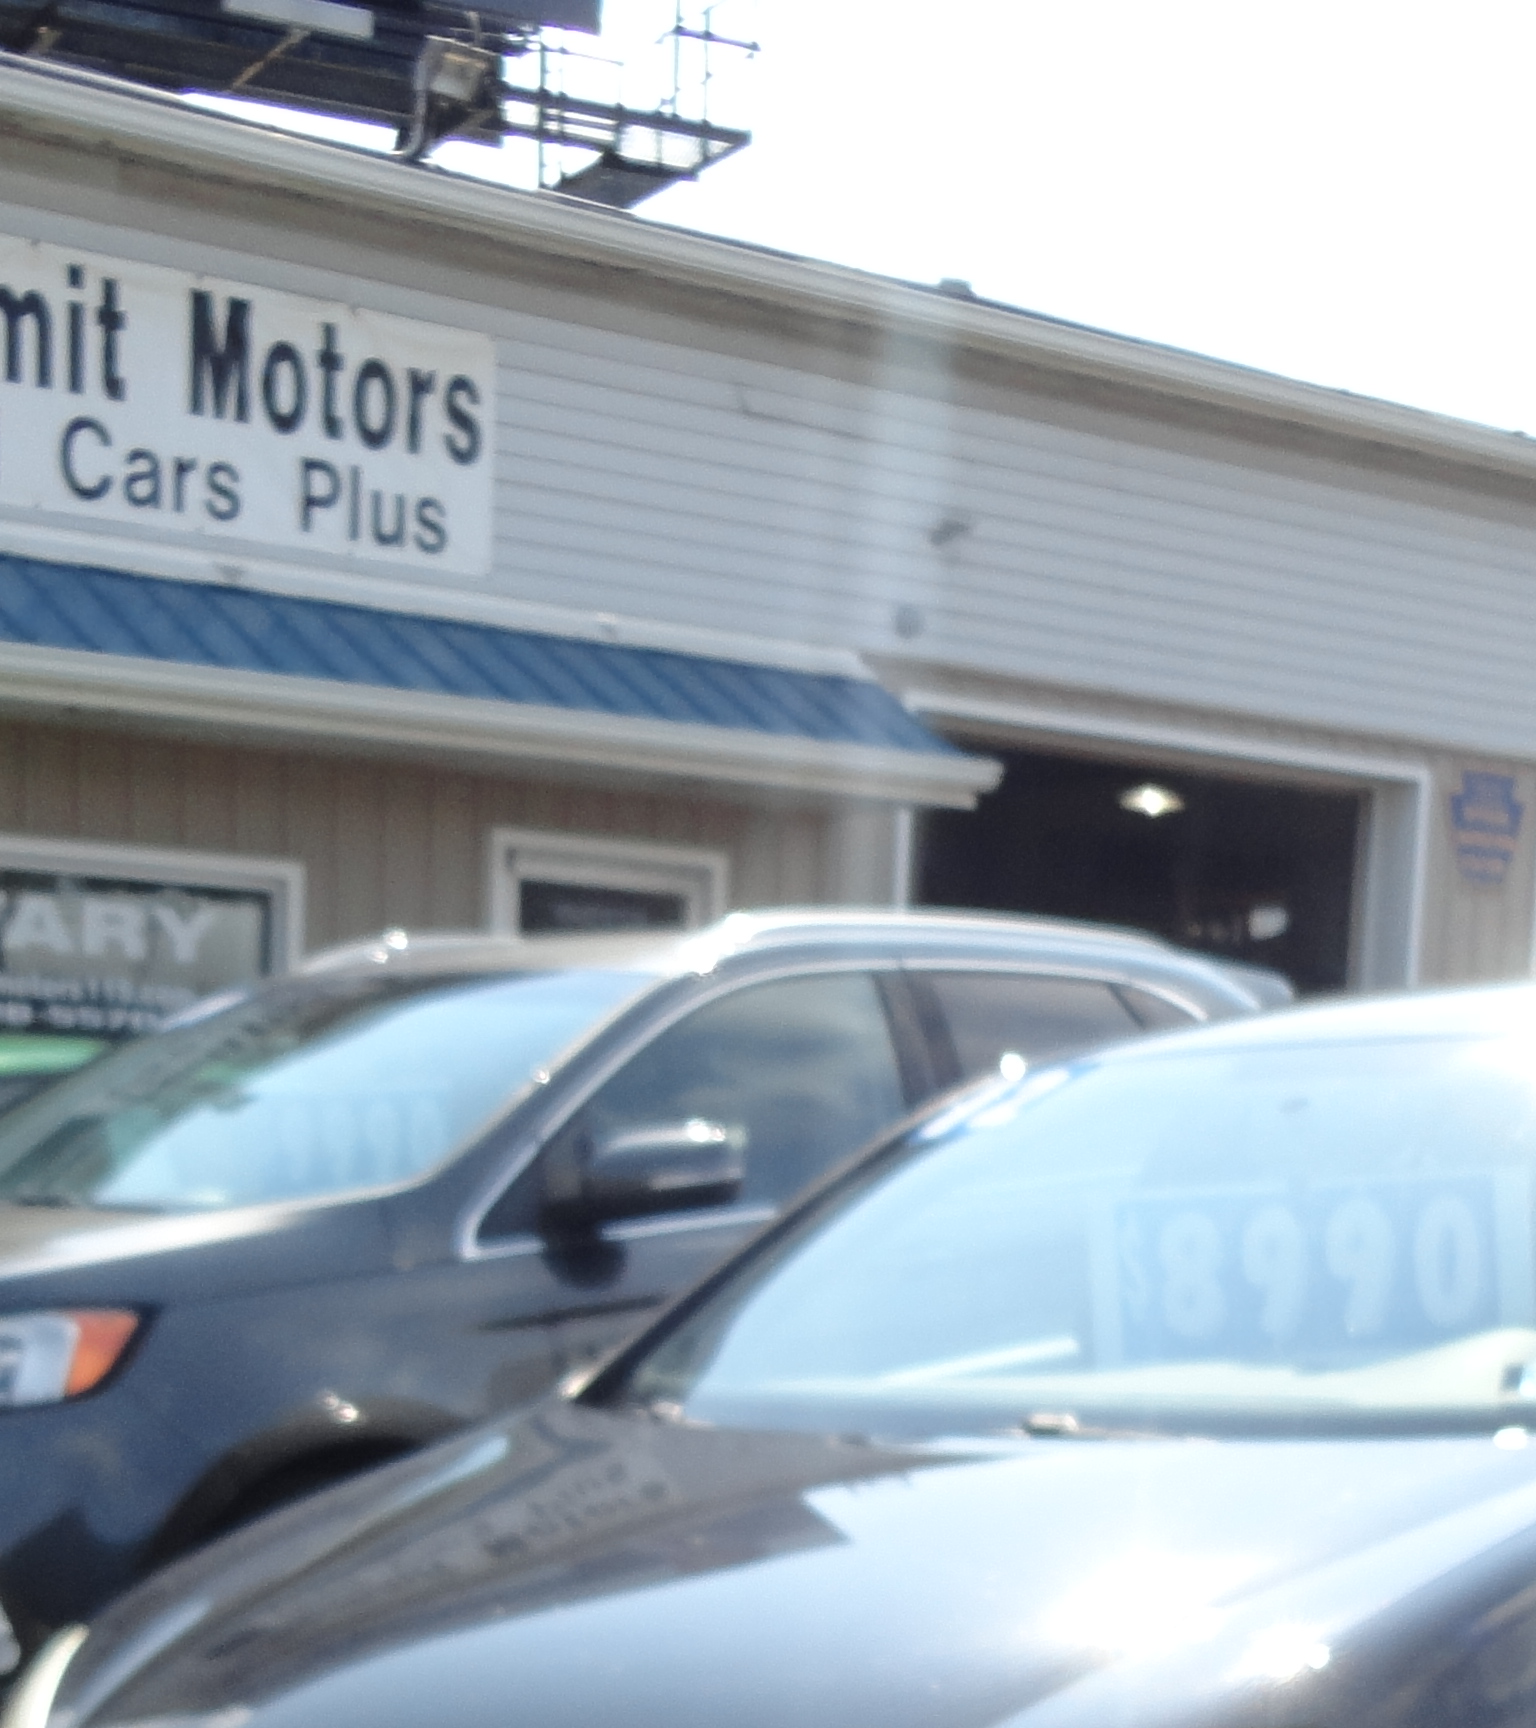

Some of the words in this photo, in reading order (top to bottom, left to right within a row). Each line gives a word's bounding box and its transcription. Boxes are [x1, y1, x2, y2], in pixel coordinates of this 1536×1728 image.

[187, 286, 485, 466] Motors
[62, 414, 244, 522] Cars
[299, 458, 448, 556] Plus
